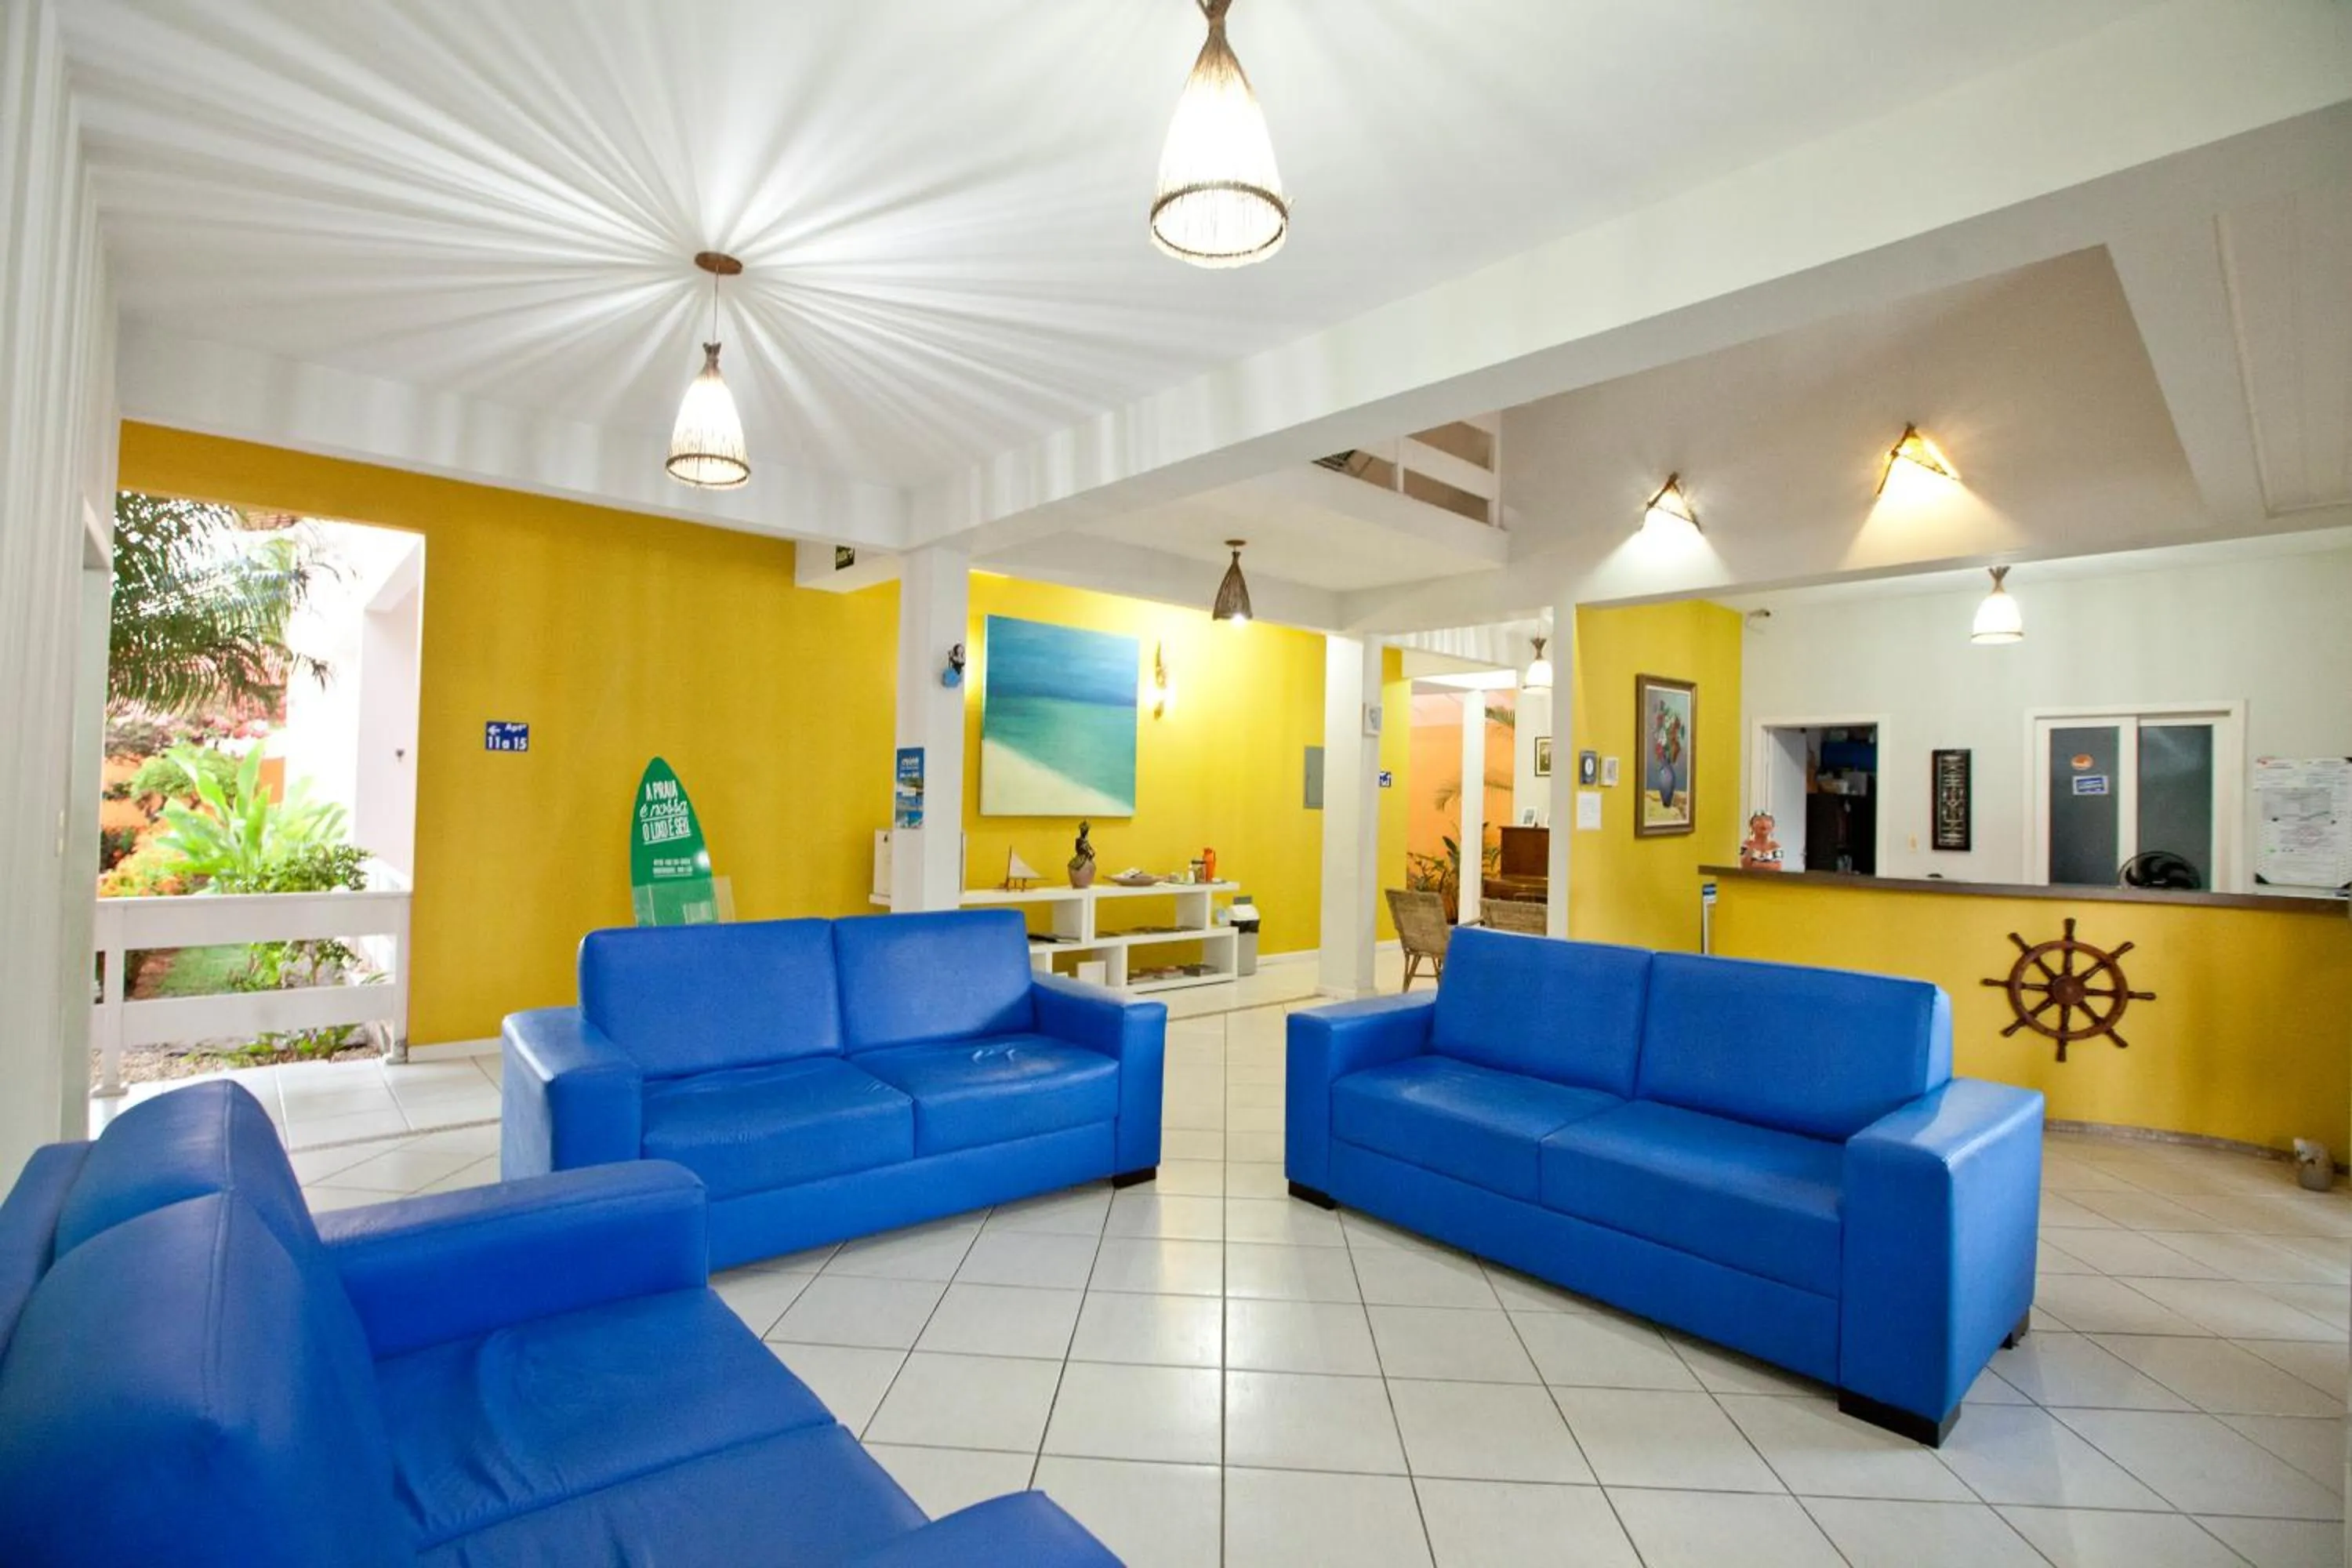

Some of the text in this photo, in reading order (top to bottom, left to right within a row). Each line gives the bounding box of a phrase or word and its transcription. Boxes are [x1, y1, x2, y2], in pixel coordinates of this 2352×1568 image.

[488, 736, 500, 749] 11
[513, 736, 527, 750] 15
[646, 782, 652, 801] A
[642, 822, 650, 841] O
